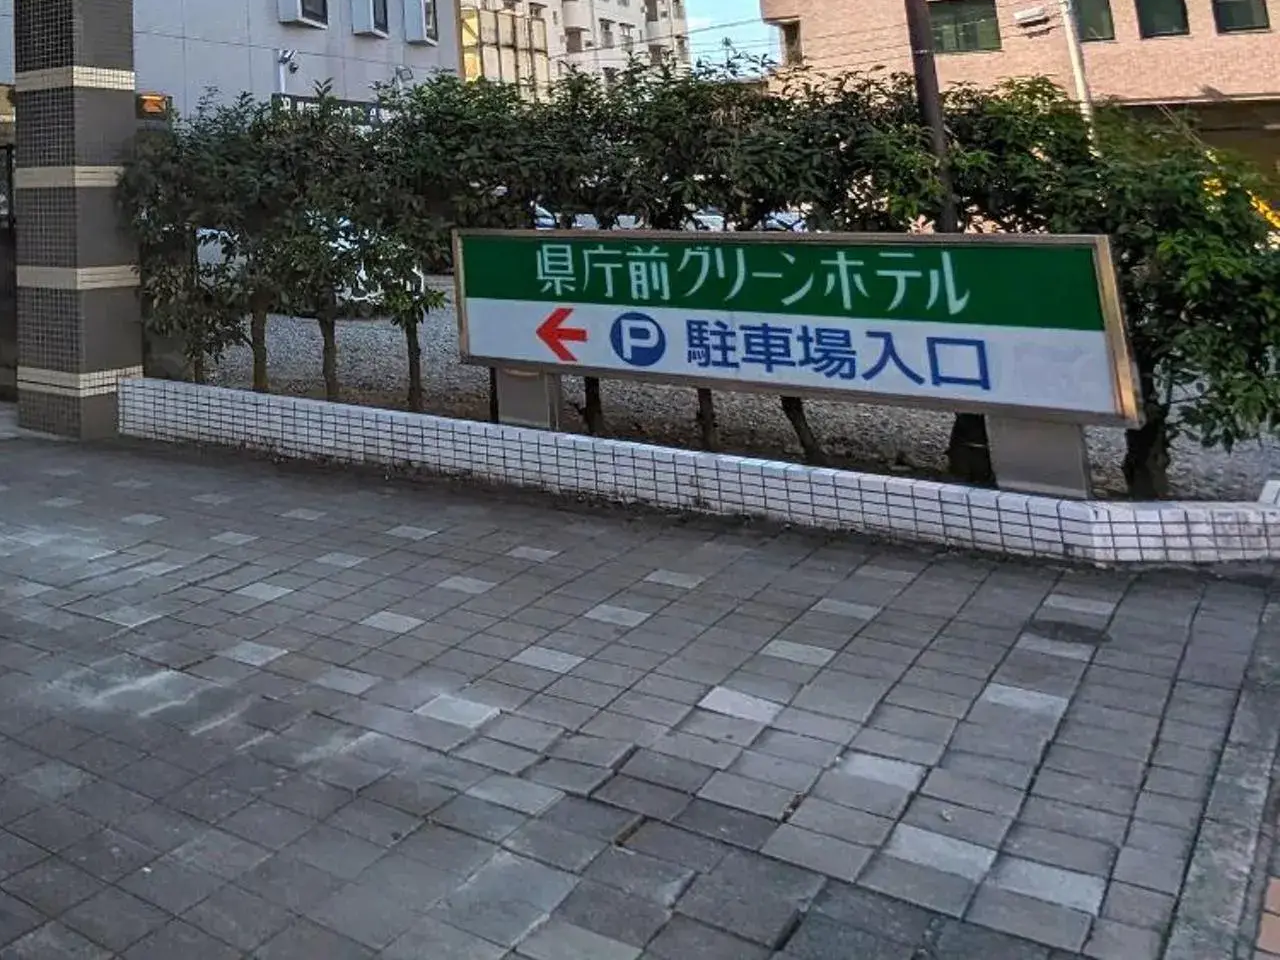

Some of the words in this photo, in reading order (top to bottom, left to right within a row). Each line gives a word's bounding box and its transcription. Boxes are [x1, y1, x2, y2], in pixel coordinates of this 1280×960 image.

[535, 243, 971, 315] 県庁前グリーンホテル
[685, 319, 992, 391] 駐車場入口
